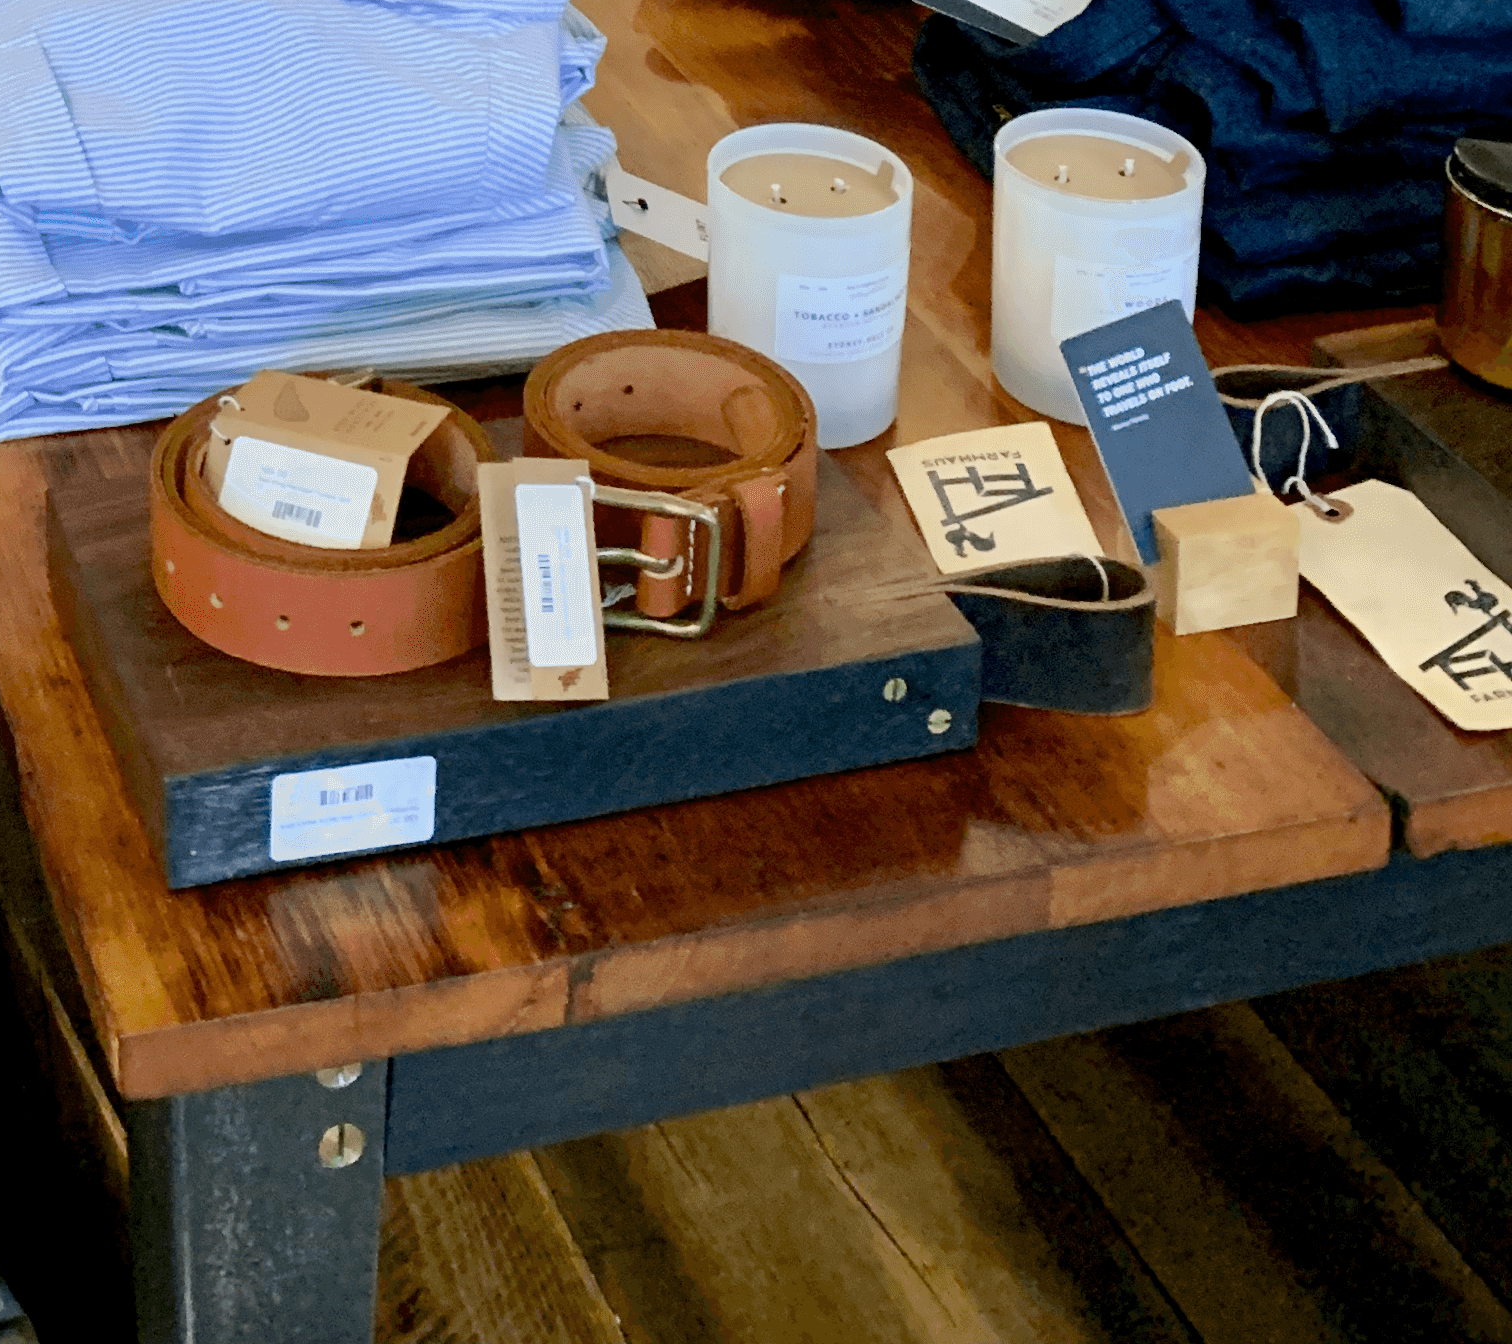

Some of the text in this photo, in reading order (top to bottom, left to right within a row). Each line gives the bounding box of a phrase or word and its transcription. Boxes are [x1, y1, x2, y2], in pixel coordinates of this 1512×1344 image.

[794, 310, 851, 322] TOBACCO
[1107, 346, 1145, 369] WORLD
[1090, 365, 1139, 391] REVEALS
[1101, 393, 1148, 418] TRAVELS
[1146, 386, 1165, 401] ON
[922, 450, 1022, 468] FARMHAUS
